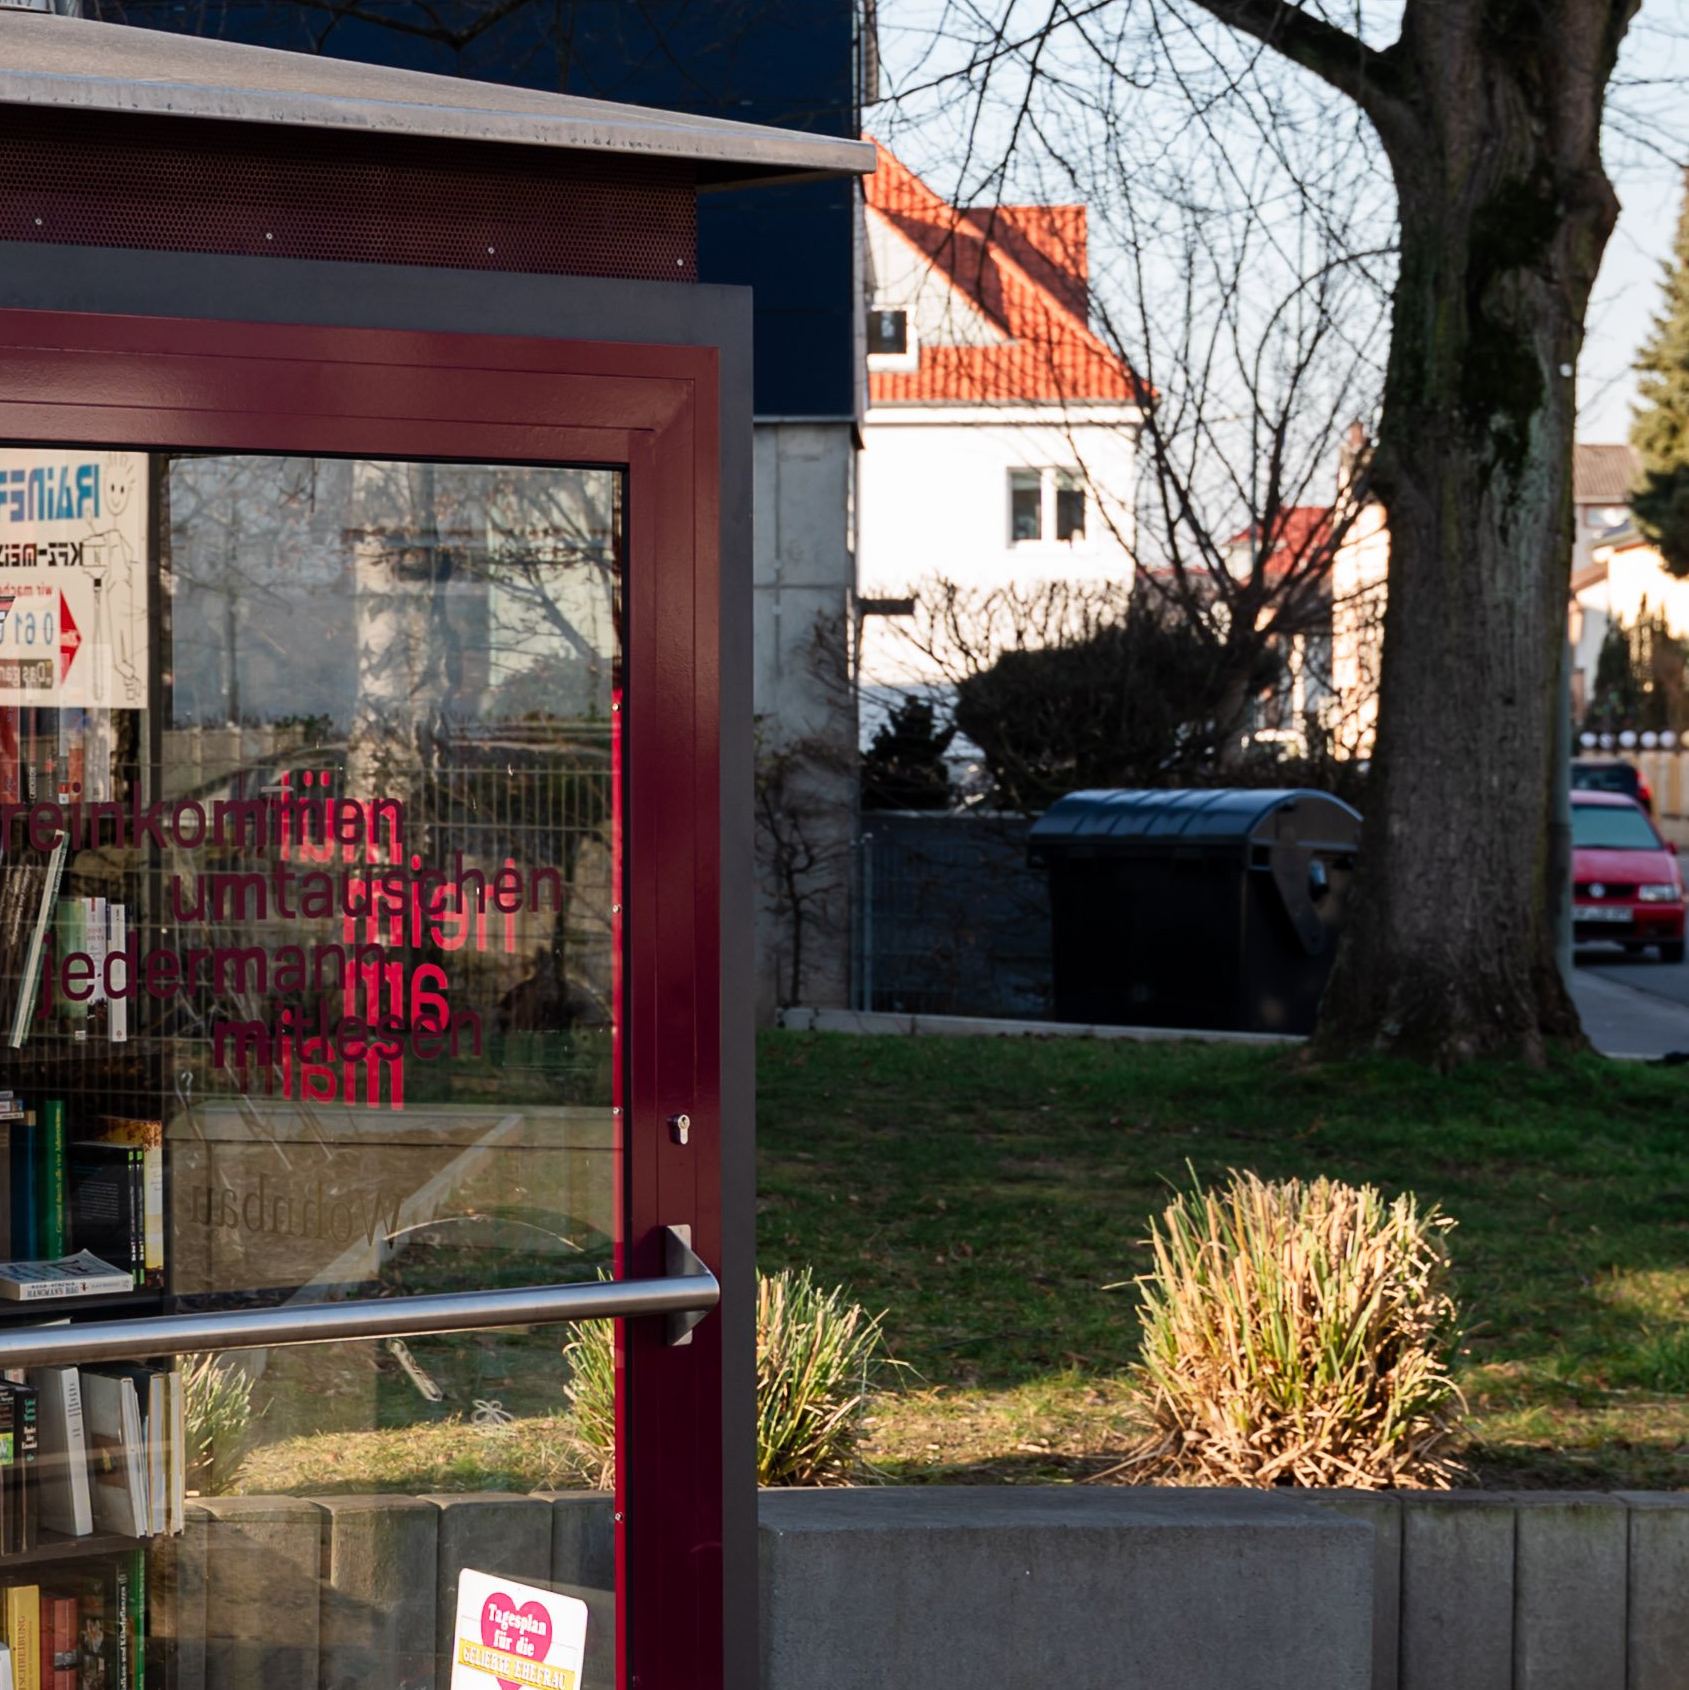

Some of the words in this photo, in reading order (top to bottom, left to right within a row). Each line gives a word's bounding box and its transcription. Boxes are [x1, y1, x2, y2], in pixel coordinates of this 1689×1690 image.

[0, 782, 404, 854] reinkommen
[172, 850, 562, 922] umtauschen
[36, 932, 386, 1019] jedermann
[213, 999, 482, 1070] mitlesen
[488, 1603, 546, 1636] Tagesplan
[494, 1629, 512, 1650] für
[516, 1636, 534, 1657] die
[463, 1646, 510, 1676] GELIEBTE
[514, 1657, 566, 1690] EHEFRAU
